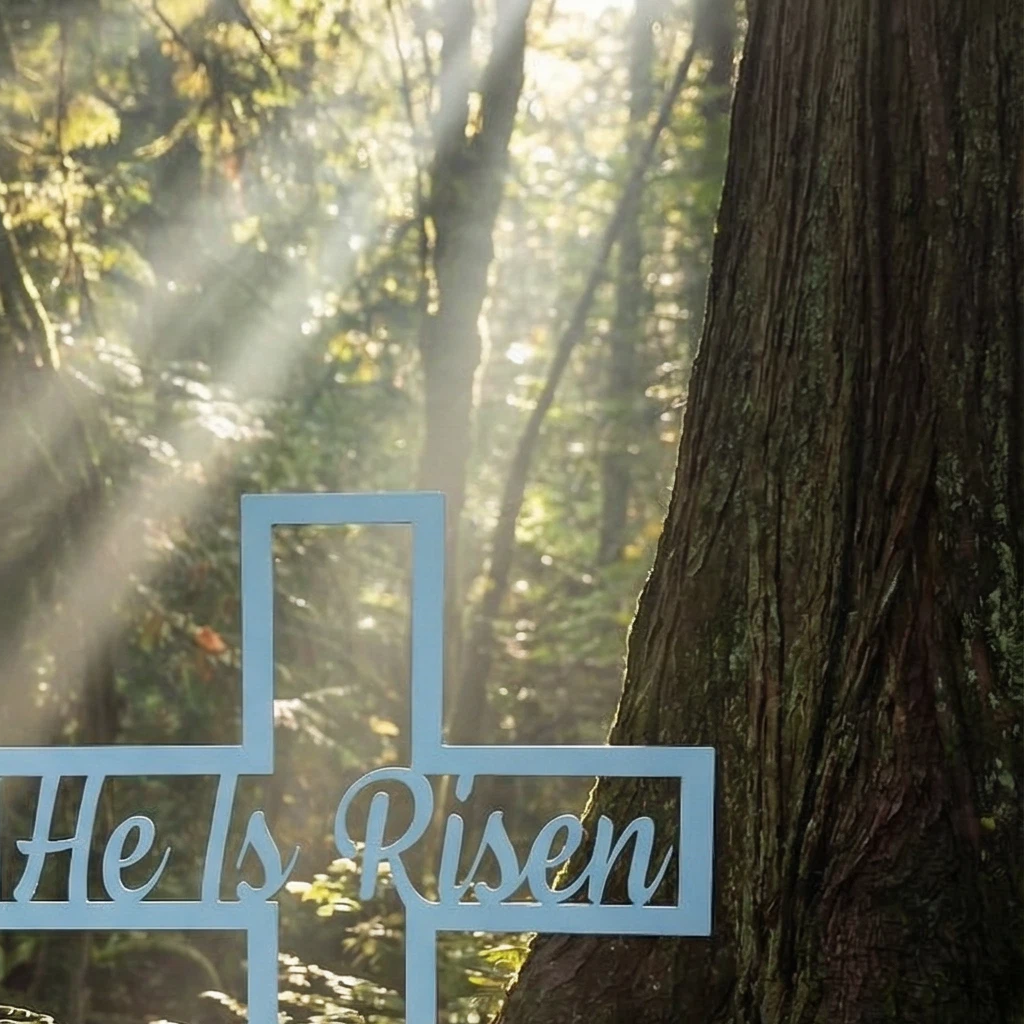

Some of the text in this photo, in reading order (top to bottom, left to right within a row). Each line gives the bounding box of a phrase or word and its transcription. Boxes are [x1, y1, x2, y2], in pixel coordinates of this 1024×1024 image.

[13, 767, 673, 905] He Is Risen
